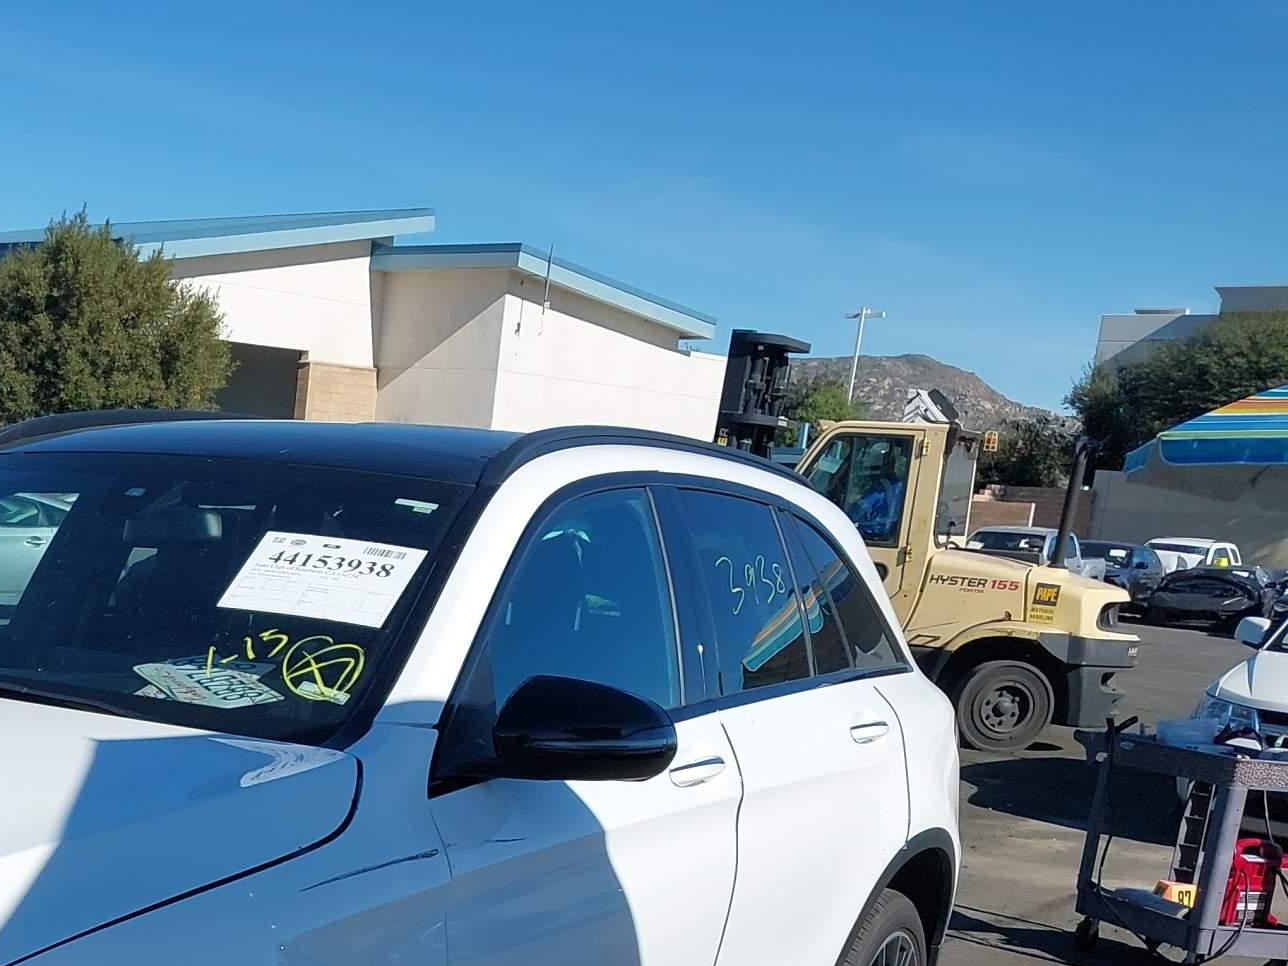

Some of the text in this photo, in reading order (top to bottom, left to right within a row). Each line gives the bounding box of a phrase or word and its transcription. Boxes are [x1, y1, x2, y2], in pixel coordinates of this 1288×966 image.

[268, 549, 396, 579] 44153938
[714, 553, 786, 615] 3938
[929, 574, 1020, 592] HYSTER 155
